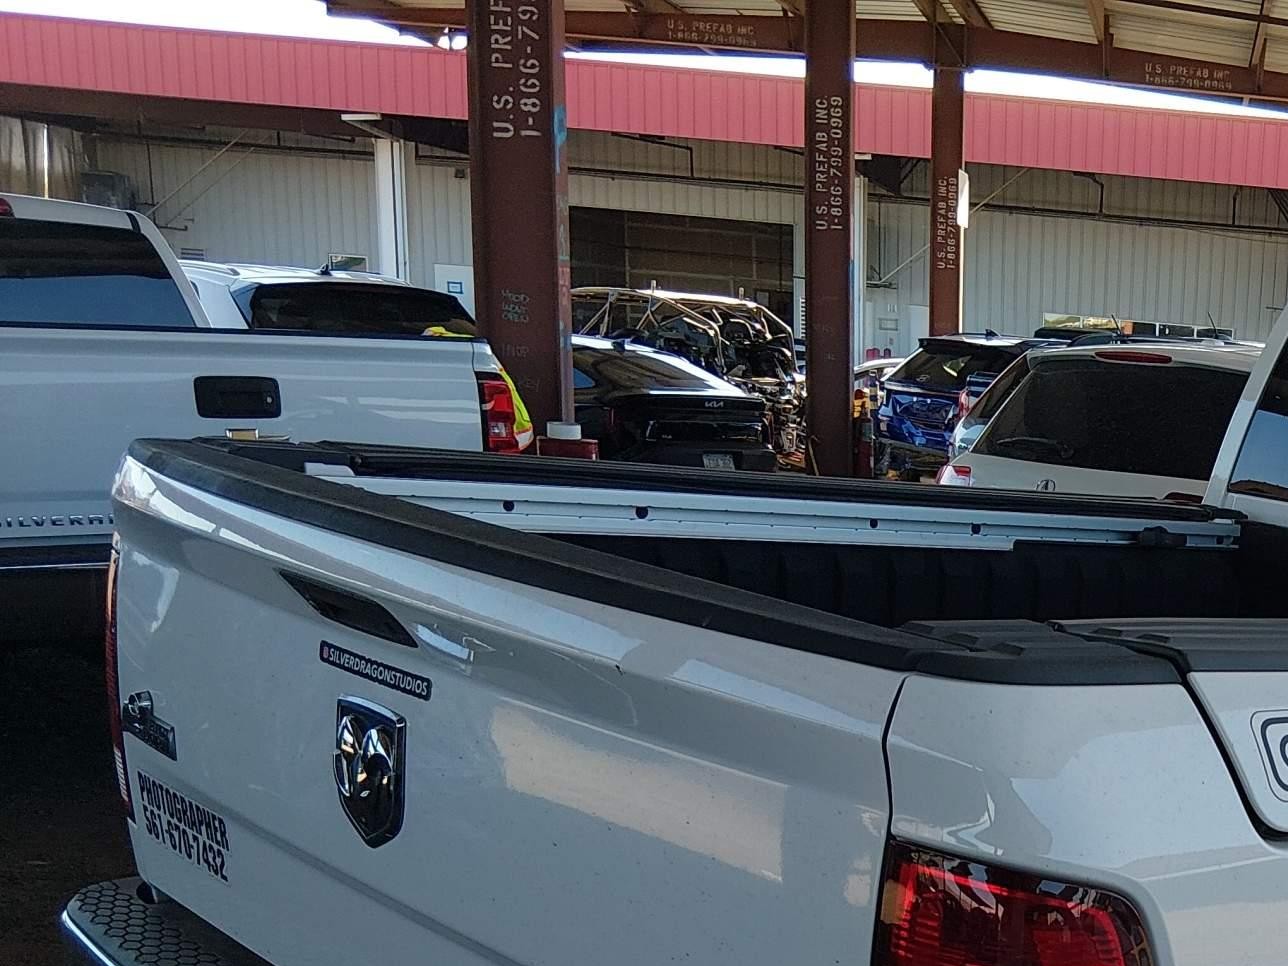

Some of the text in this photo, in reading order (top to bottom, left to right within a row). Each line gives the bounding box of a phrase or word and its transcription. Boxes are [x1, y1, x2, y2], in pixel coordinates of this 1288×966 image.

[518, 0, 541, 137] 1-866-79
[492, 86, 515, 138] U.S.
[815, 95, 828, 230] U.S. PREFAB INC.
[830, 97, 843, 229] 1-866-799-0969
[937, 202, 947, 243] PREFAB
[0, 513, 114, 528] ILVERA
[329, 647, 428, 696] SILVERDRAGONSTUDIOS
[137, 770, 230, 852] PHOTOGRAPHER
[142, 803, 229, 882] 561-670-7432
